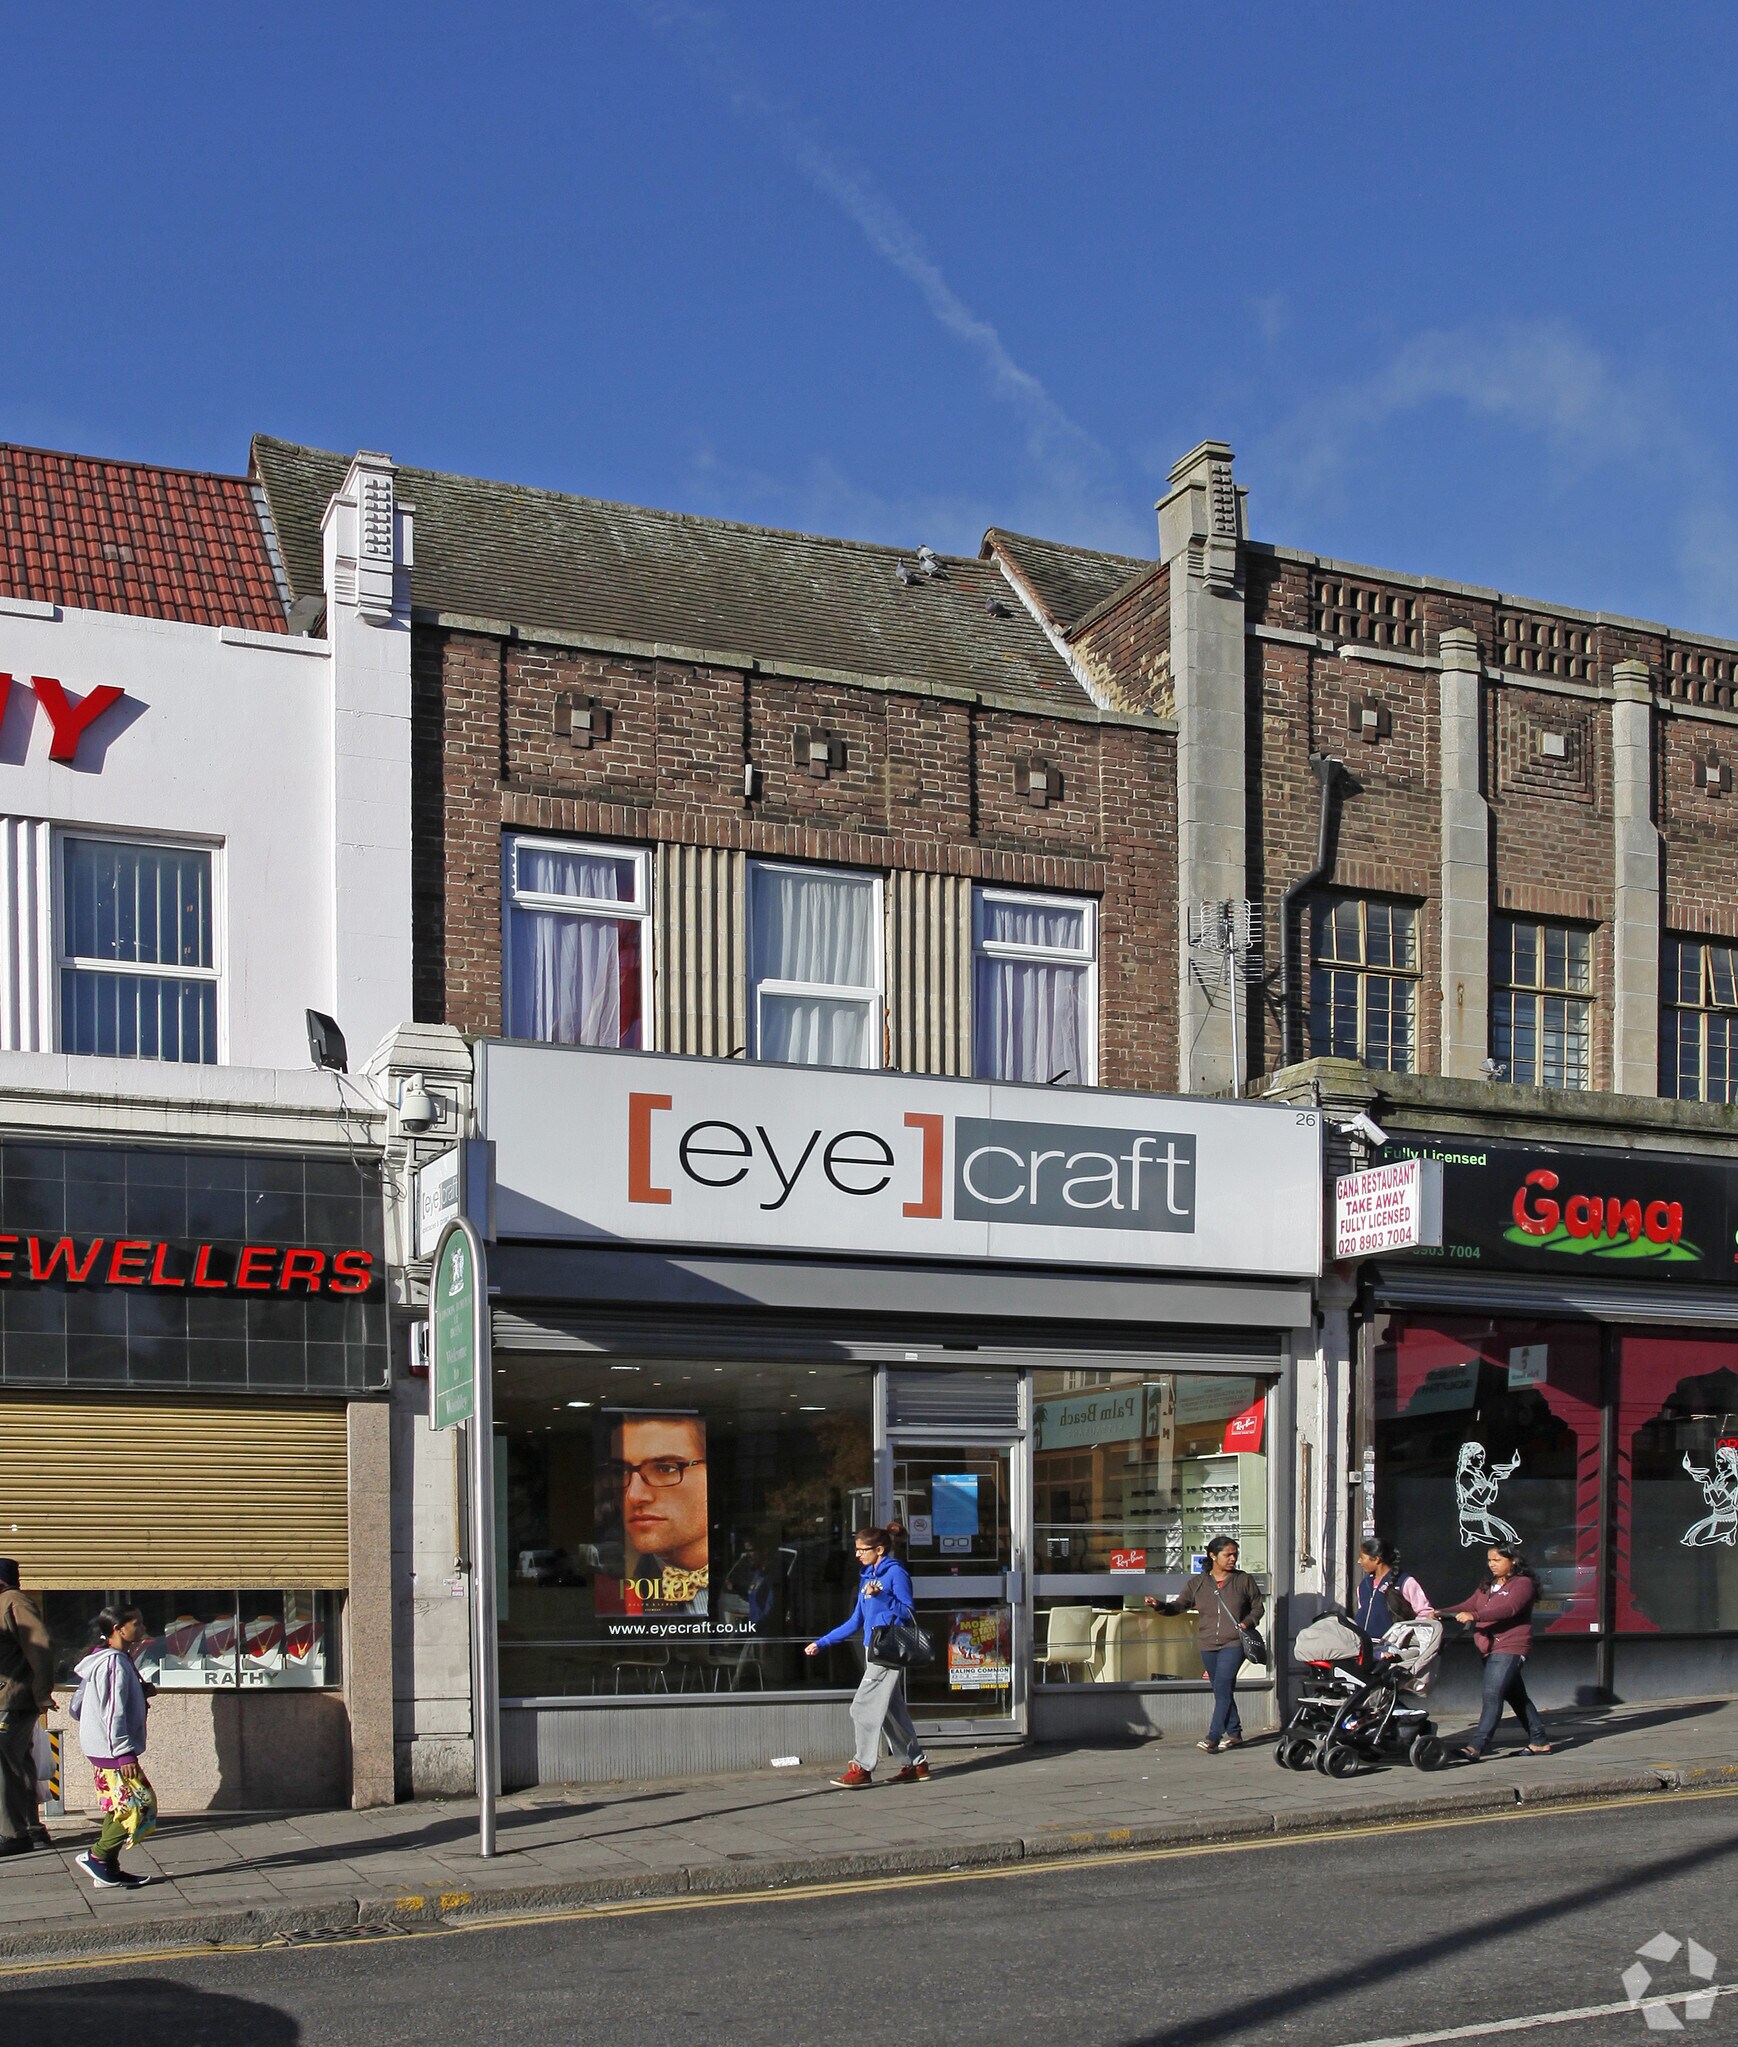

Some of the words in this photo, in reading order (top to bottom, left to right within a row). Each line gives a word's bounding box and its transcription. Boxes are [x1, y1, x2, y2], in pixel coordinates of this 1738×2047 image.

[1295, 1112, 1316, 1127] 26
[962, 1136, 1190, 1215] craft
[1337, 1179, 1359, 1200] GANA
[1361, 1163, 1416, 1194] RESTAURANT
[1345, 1197, 1373, 1216] TAKE
[1375, 1189, 1406, 1210] AWAY
[1512, 1168, 1684, 1246] Gana
[1340, 1215, 1366, 1235] FULLY
[1368, 1206, 1411, 1229] LICENSED
[1338, 1238, 1357, 1255] 020
[1359, 1232, 1384, 1251] 8903
[1387, 1226, 1412, 1246] 7004
[1449, 1245, 1481, 1259] 7004
[619, 1577, 690, 1600] POLO
[608, 1620, 757, 1637] www.eyecraft.co.uk
[970, 1631, 998, 1645] CIRCU
[204, 1672, 279, 1685] RATHY
